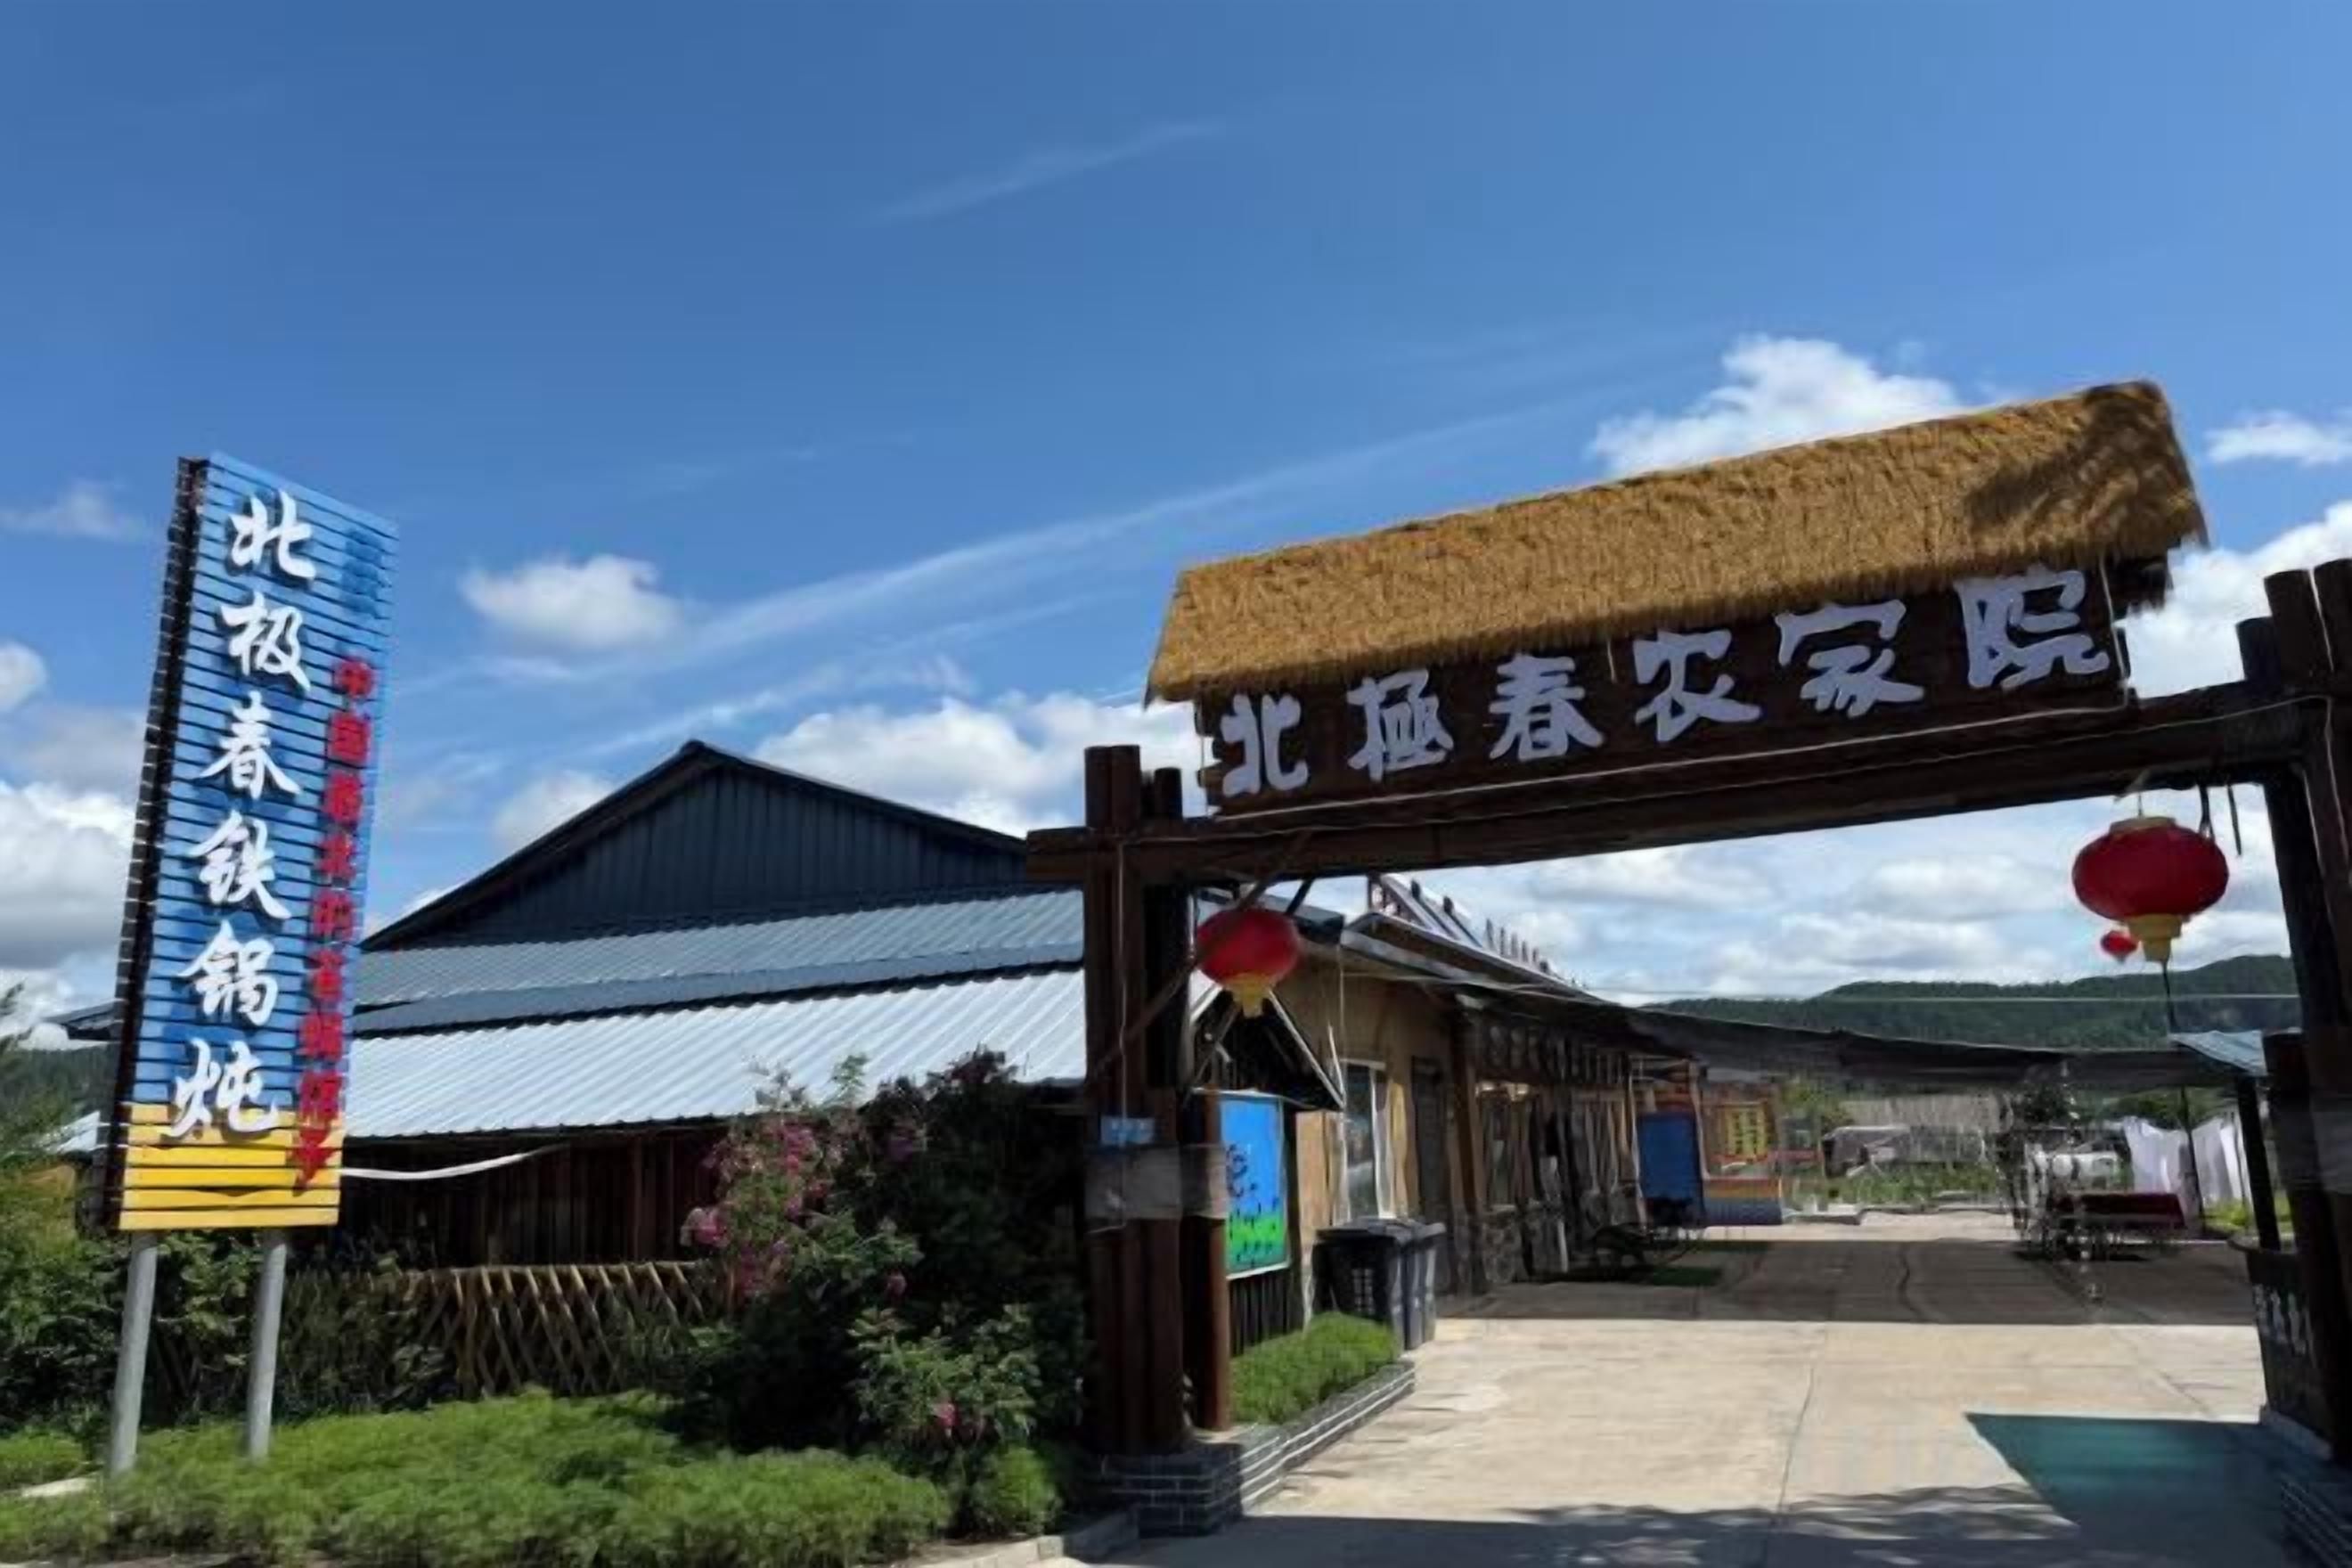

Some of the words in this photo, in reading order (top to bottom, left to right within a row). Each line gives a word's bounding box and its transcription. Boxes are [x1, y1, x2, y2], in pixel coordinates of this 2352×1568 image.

[166, 490, 316, 1139] 北极春铁锅炖
